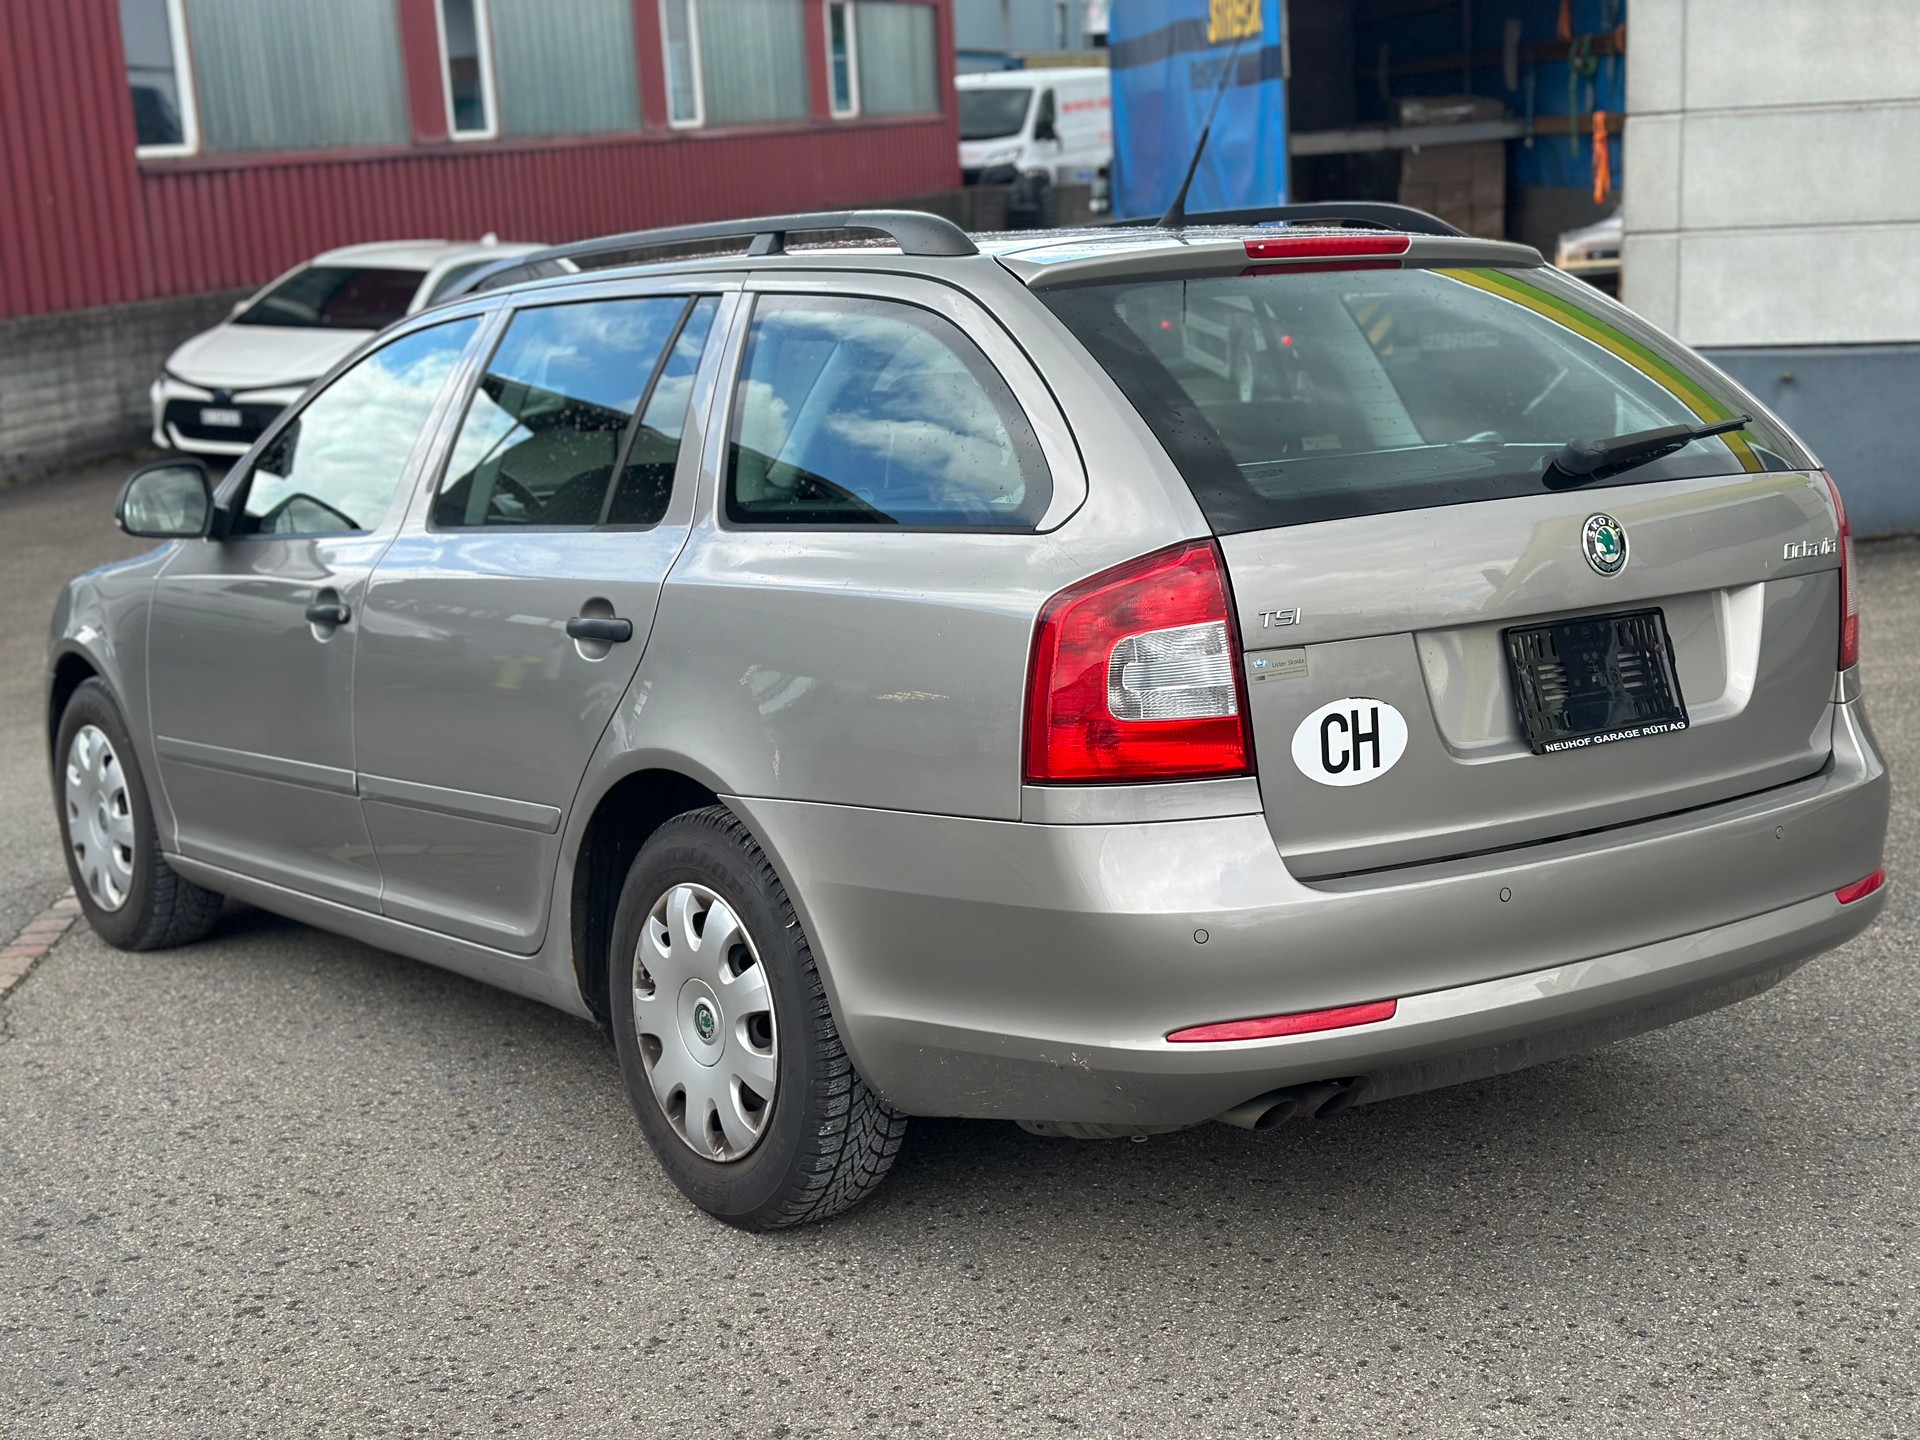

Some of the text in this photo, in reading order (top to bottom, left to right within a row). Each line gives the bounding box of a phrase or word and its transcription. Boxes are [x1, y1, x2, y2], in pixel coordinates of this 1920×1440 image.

[1259, 607, 1302, 628] TSI
[1320, 707, 1381, 774] CH
[1545, 721, 1686, 752] NEUHOF GARAGE RÜTI AG
